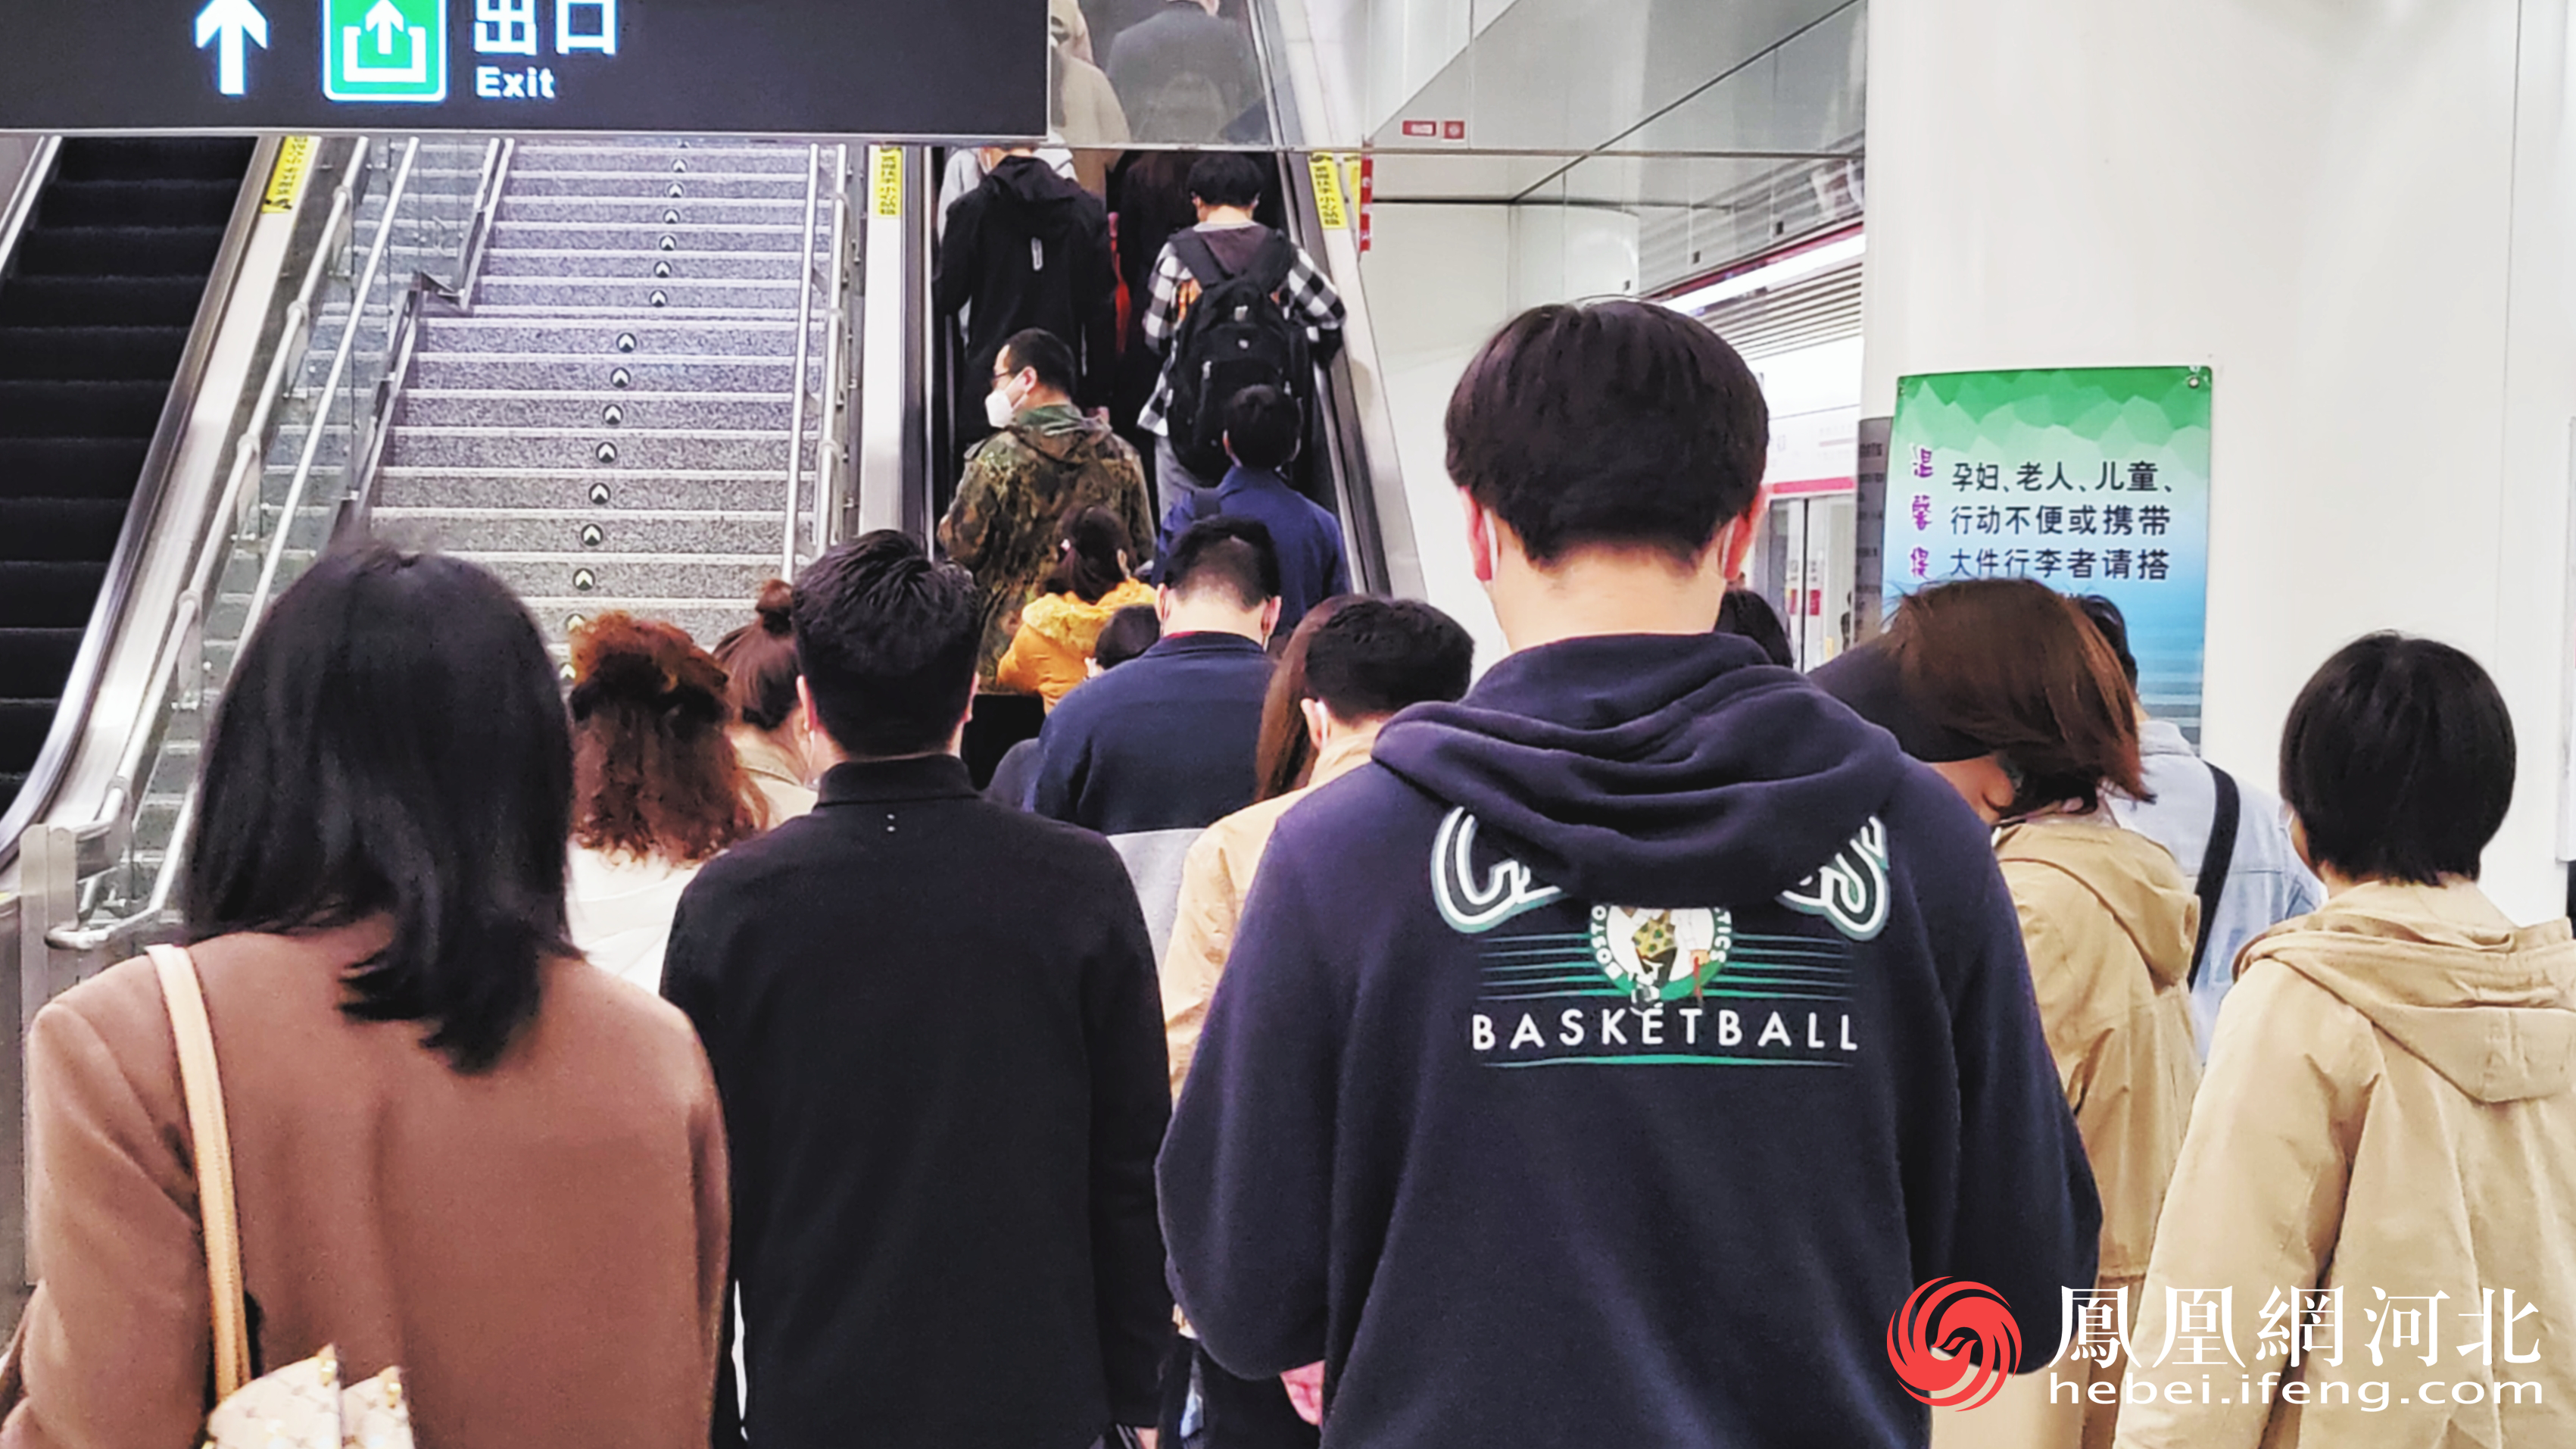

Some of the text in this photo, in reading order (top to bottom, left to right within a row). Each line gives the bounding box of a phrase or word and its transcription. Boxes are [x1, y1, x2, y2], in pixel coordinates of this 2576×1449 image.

[474, 0, 616, 55] 出口
[476, 66, 555, 98] Exit
[1951, 461, 2172, 493] 孕妇、老人、儿童、
[1950, 504, 2171, 536] 行动不便或携带
[1949, 548, 2170, 581] 大件行李者请搭
[1709, 907, 1732, 963] TICS
[1472, 1009, 1857, 1051] BASKETBALL
